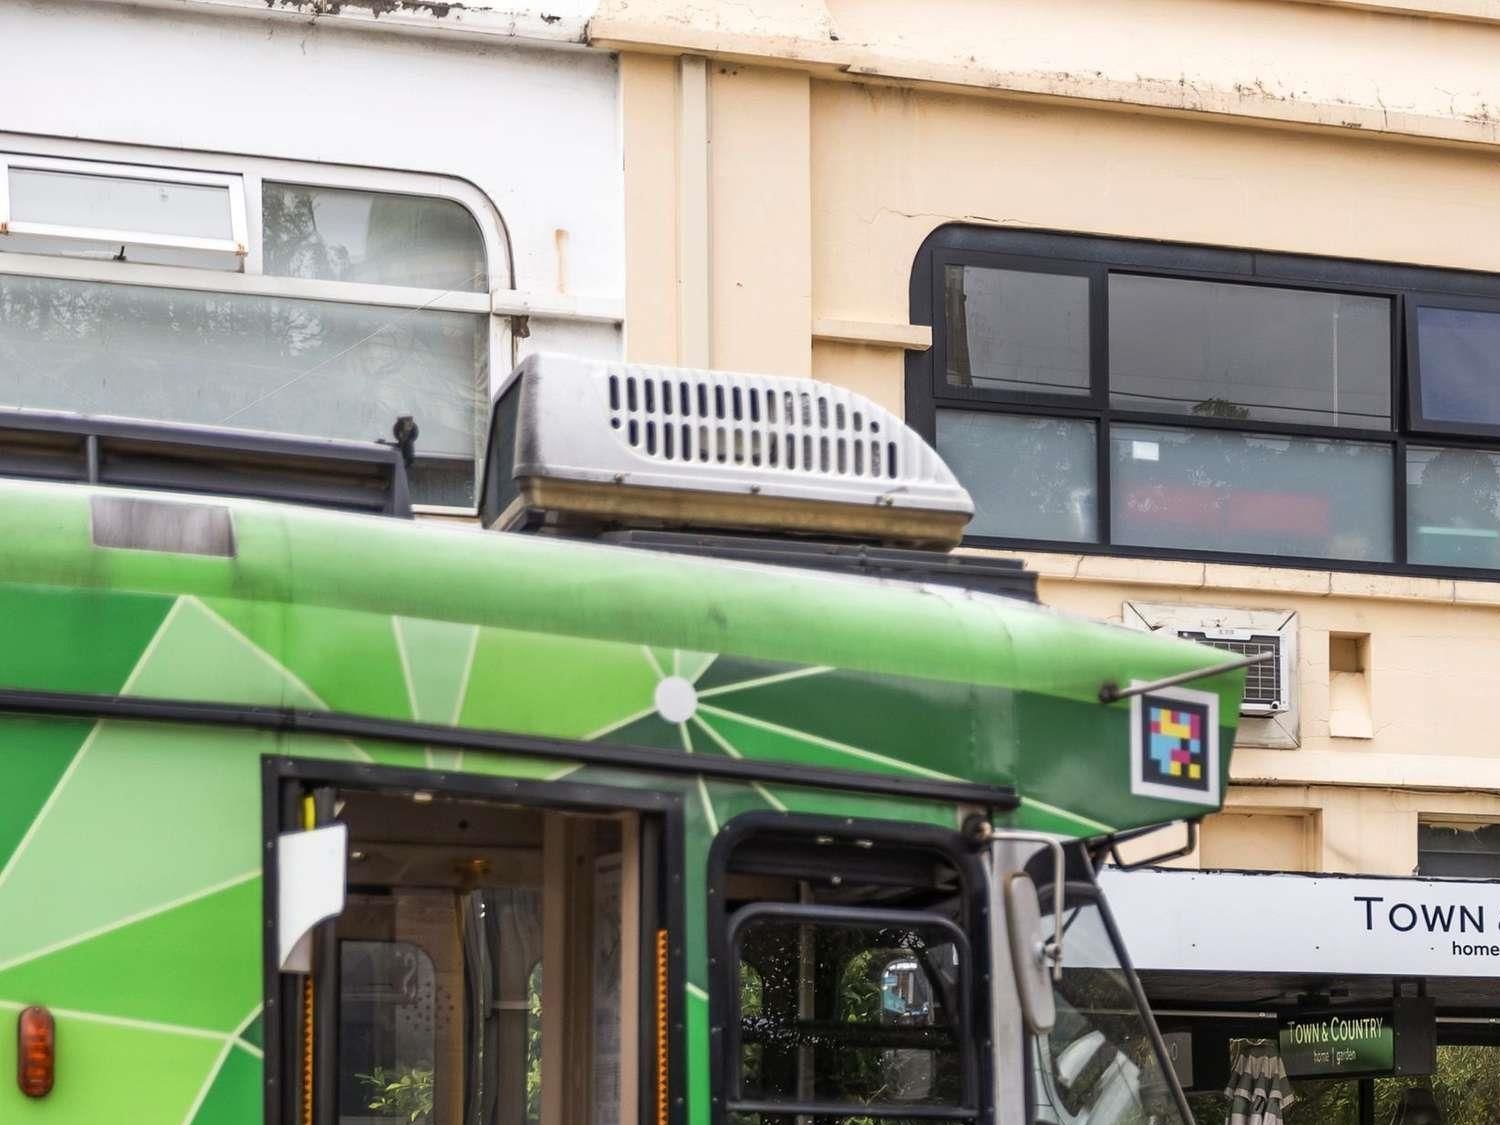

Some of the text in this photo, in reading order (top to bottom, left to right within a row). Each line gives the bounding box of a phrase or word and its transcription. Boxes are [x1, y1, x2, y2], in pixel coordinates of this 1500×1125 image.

[1354, 896, 1485, 934] TOWN
[1452, 941, 1500, 957] home
[1321, 1022, 1329, 1042] &
[1330, 1017, 1383, 1041] COUNTRY
